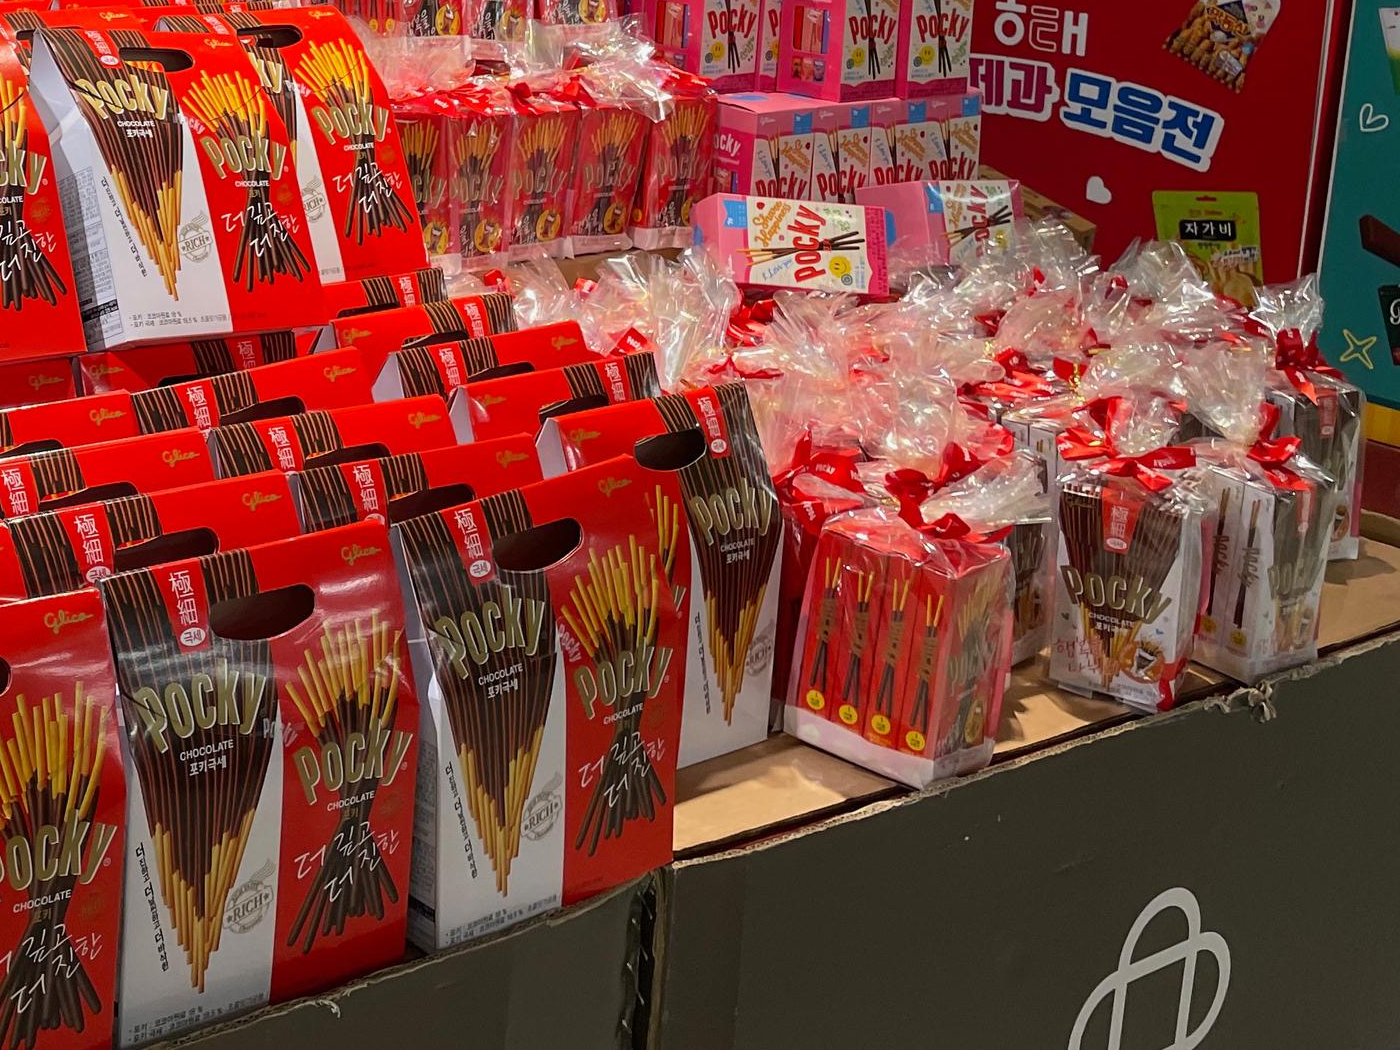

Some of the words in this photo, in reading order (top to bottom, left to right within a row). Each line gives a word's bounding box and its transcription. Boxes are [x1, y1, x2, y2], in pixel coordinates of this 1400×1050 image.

[706, 3, 756, 39] Pocky
[848, 9, 897, 45] Pocky
[1064, 73, 1217, 164] 모음전
[201, 129, 287, 180] Pocky
[787, 204, 826, 283] Pocky
[1185, 221, 1232, 237] 자가비
[1060, 564, 1172, 624] Pocky
[43, 611, 94, 634] Glico
[436, 587, 547, 680] Pocky
[1088, 612, 1135, 629] CHOCOLATE
[574, 643, 673, 720] Pocky
[137, 656, 268, 755] Pocky
[179, 739, 234, 762] CHOCOLATE
[188, 756, 227, 777] 포키극세
[292, 719, 415, 805] Pocky
[12, 888, 72, 914] CHOCOLATE
